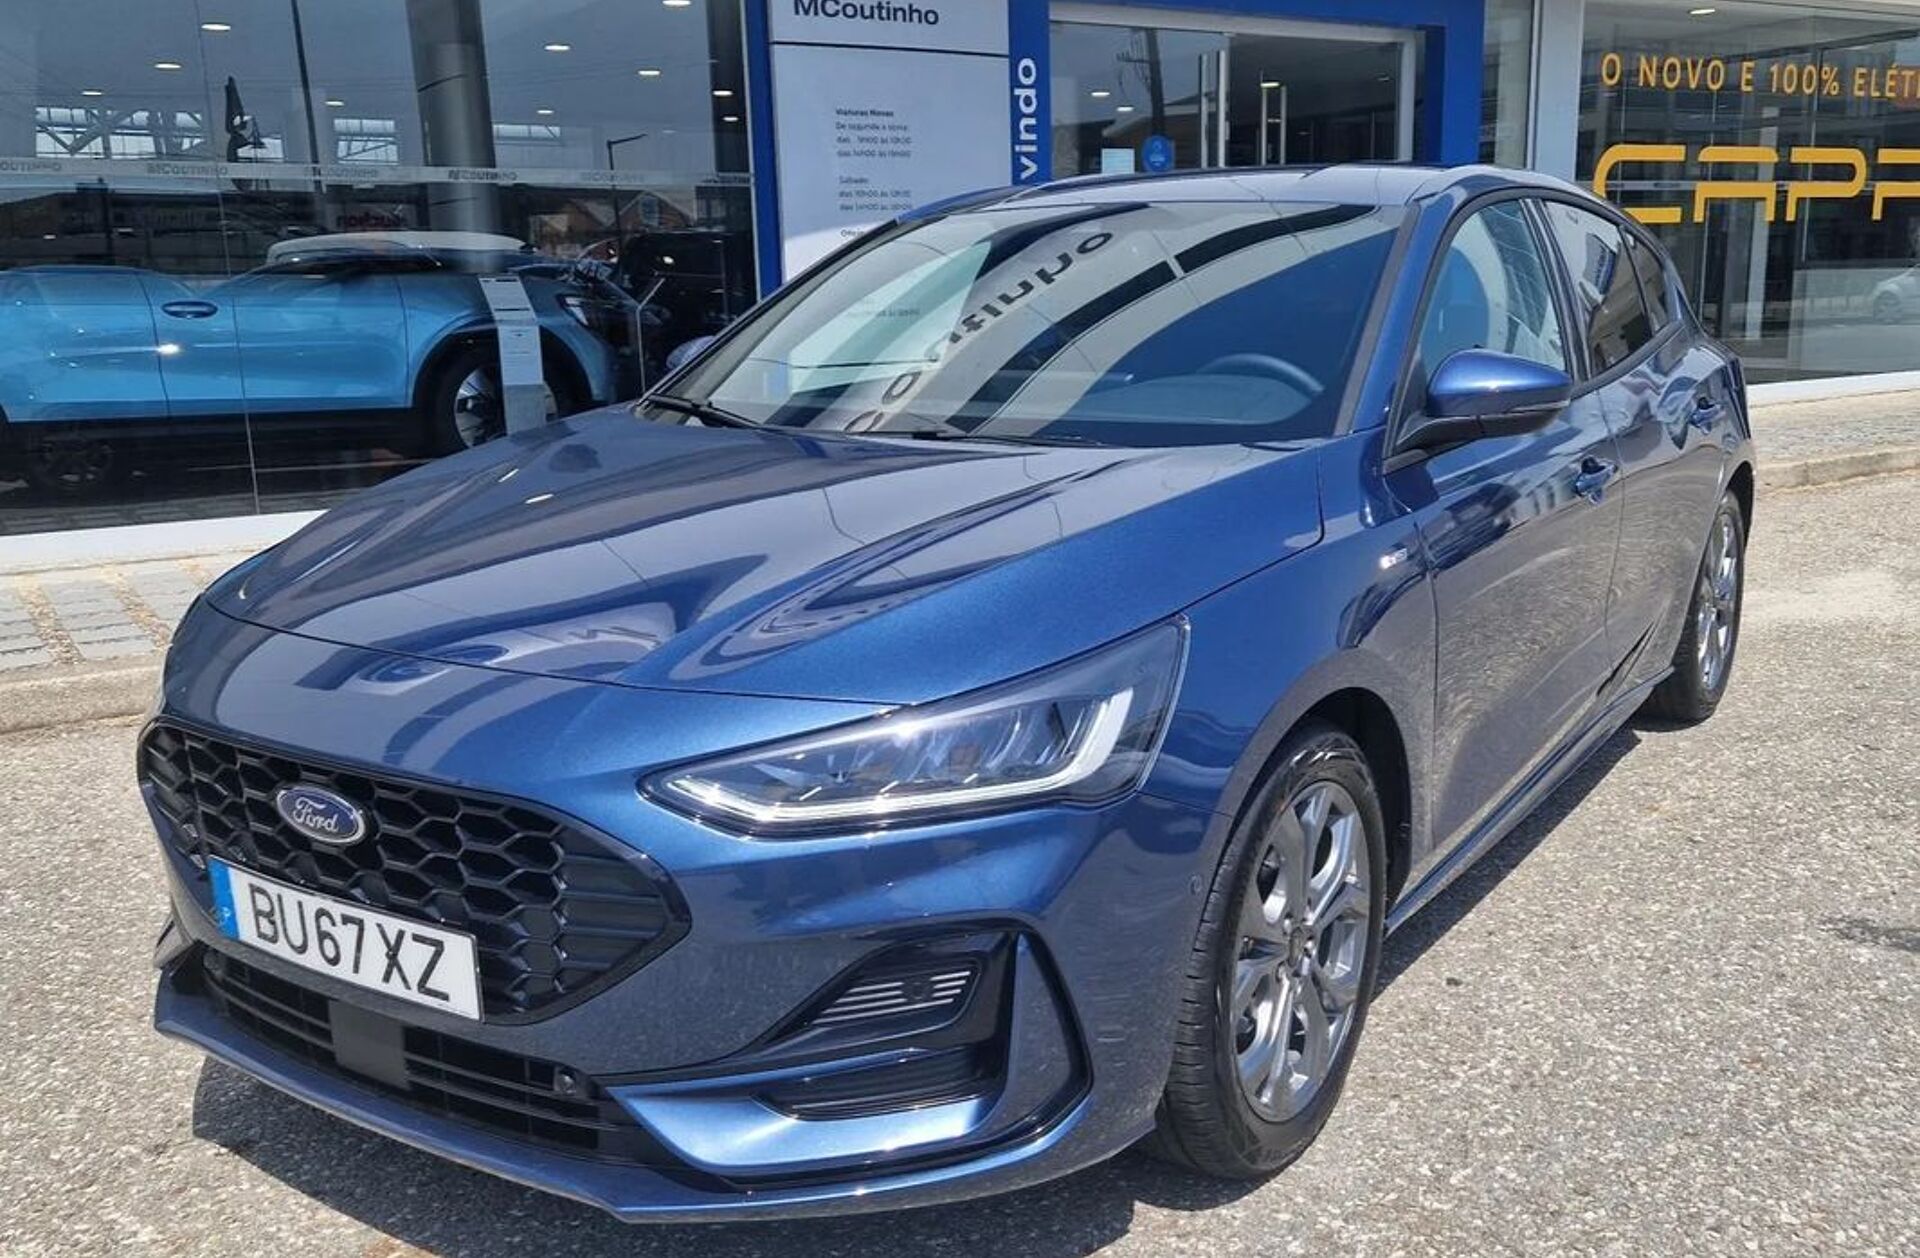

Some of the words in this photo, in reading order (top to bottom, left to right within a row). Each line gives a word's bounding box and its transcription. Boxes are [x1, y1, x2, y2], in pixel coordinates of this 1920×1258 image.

[793, 0, 940, 25] MCoutinho
[1601, 52, 1622, 87] O
[1638, 55, 1726, 91] NOVO
[1740, 61, 1756, 92] E
[1769, 64, 1840, 97] 100%
[1853, 62, 1920, 98] ELÉT
[1013, 57, 1038, 180] vindo
[292, 796, 340, 833] Ford
